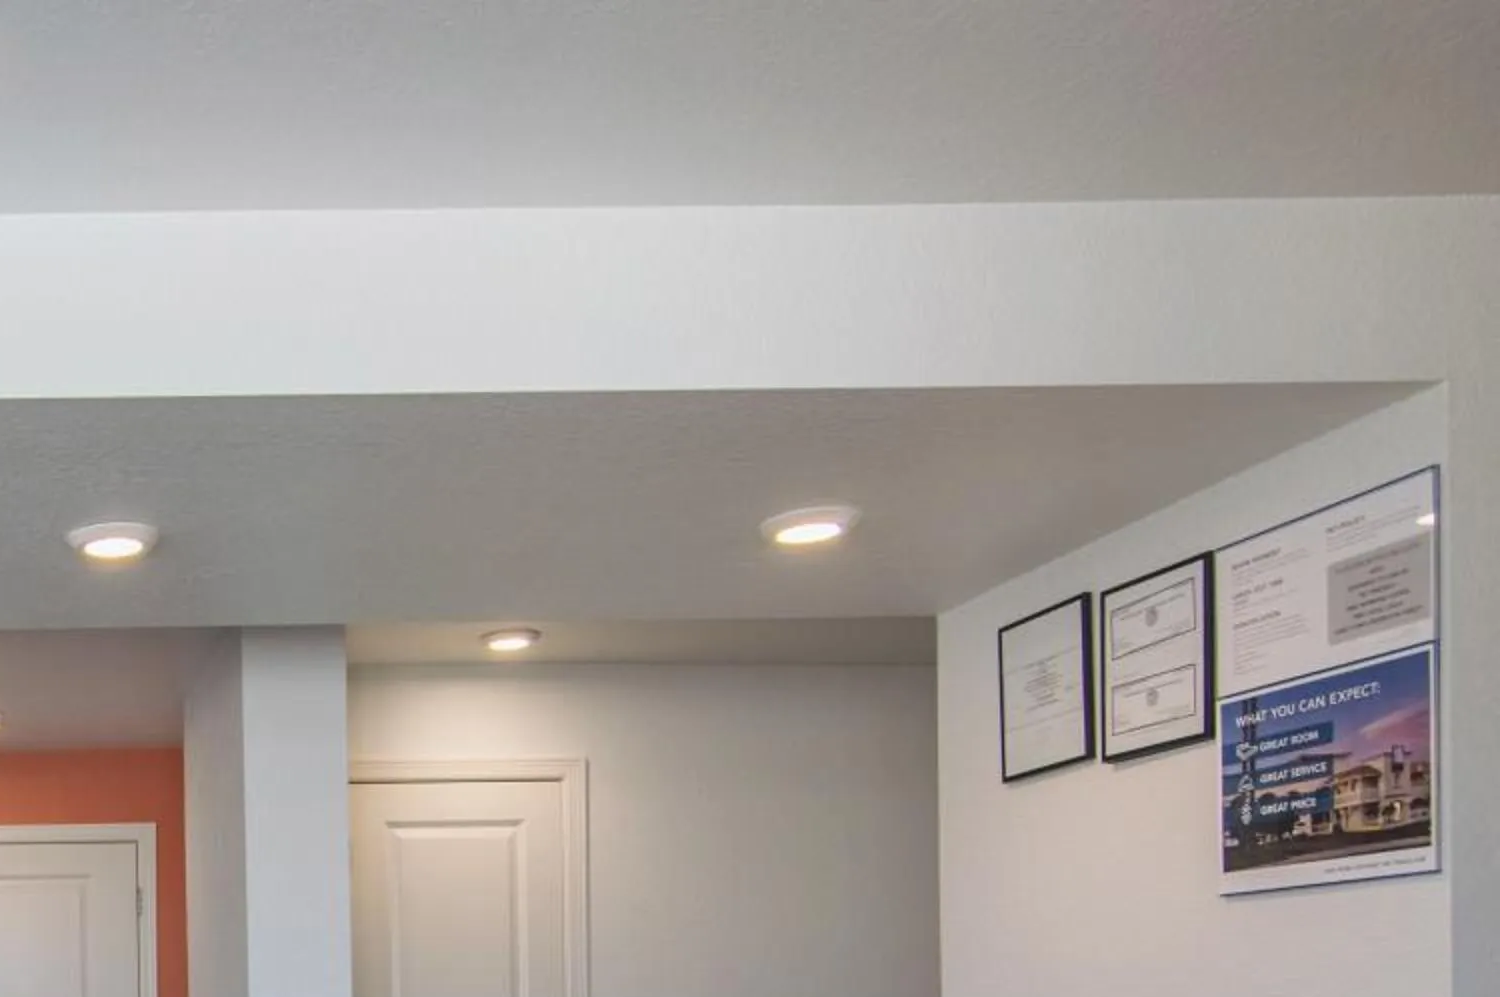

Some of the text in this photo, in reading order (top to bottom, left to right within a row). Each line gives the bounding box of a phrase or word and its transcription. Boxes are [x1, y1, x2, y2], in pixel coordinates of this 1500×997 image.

[1236, 681, 1381, 728] WHAT YOU CAN EXPECT:
[1259, 737, 1288, 752] GREAT
[1259, 768, 1288, 783] GREAT
[1259, 801, 1288, 815] GREAT
